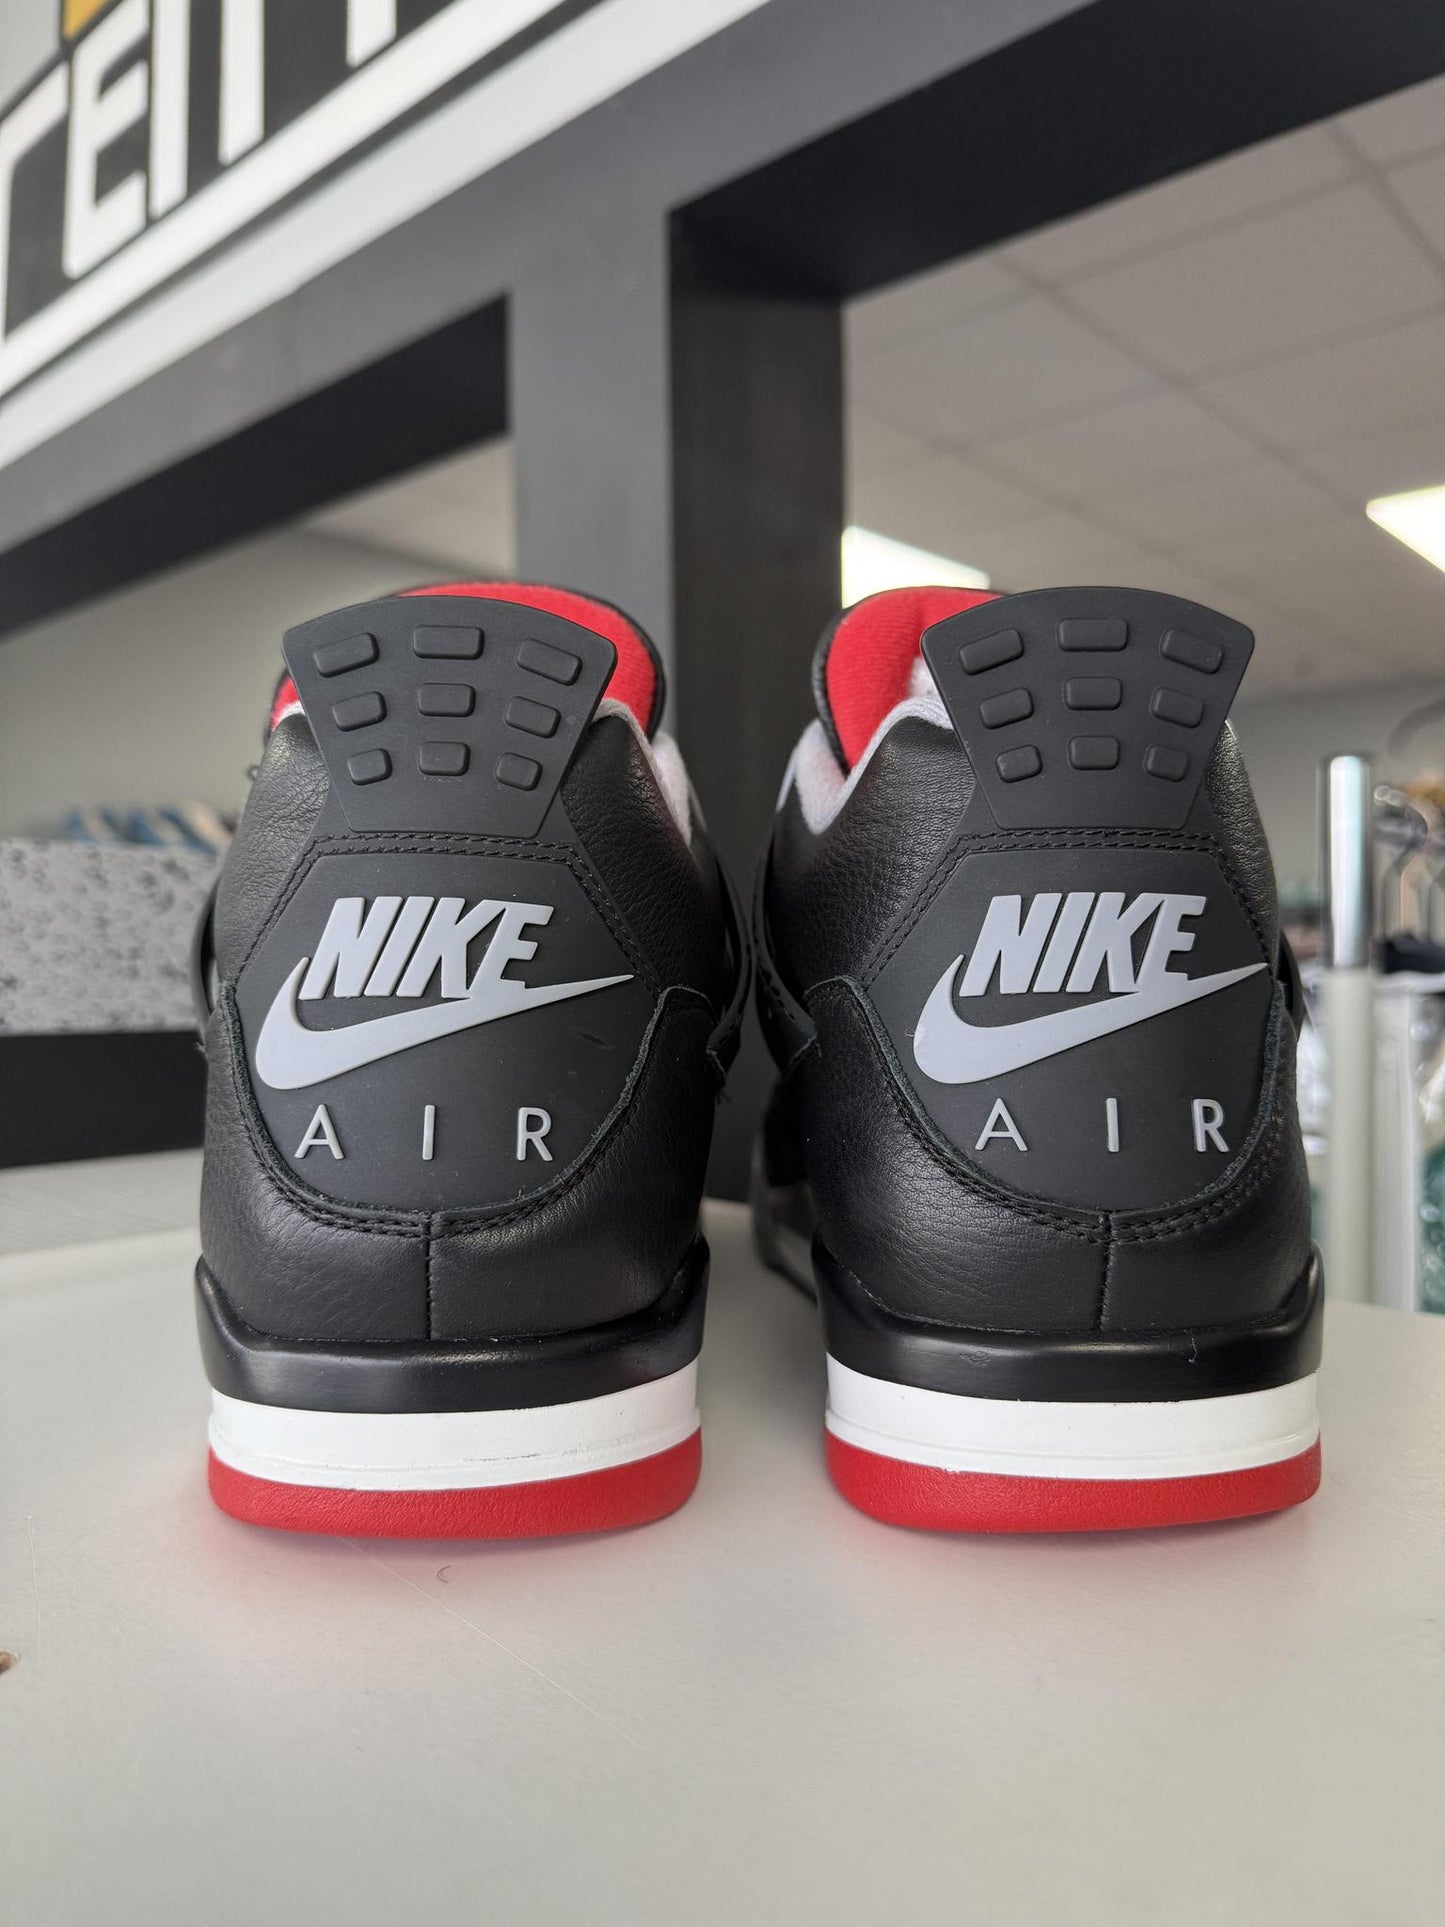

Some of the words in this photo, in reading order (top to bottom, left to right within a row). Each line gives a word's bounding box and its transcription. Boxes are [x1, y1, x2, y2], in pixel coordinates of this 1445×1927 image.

[299, 896, 554, 1000] NIKE
[959, 892, 1206, 997] NIKE
[294, 1103, 554, 1162] AIR
[974, 1097, 1230, 1153] AIR
